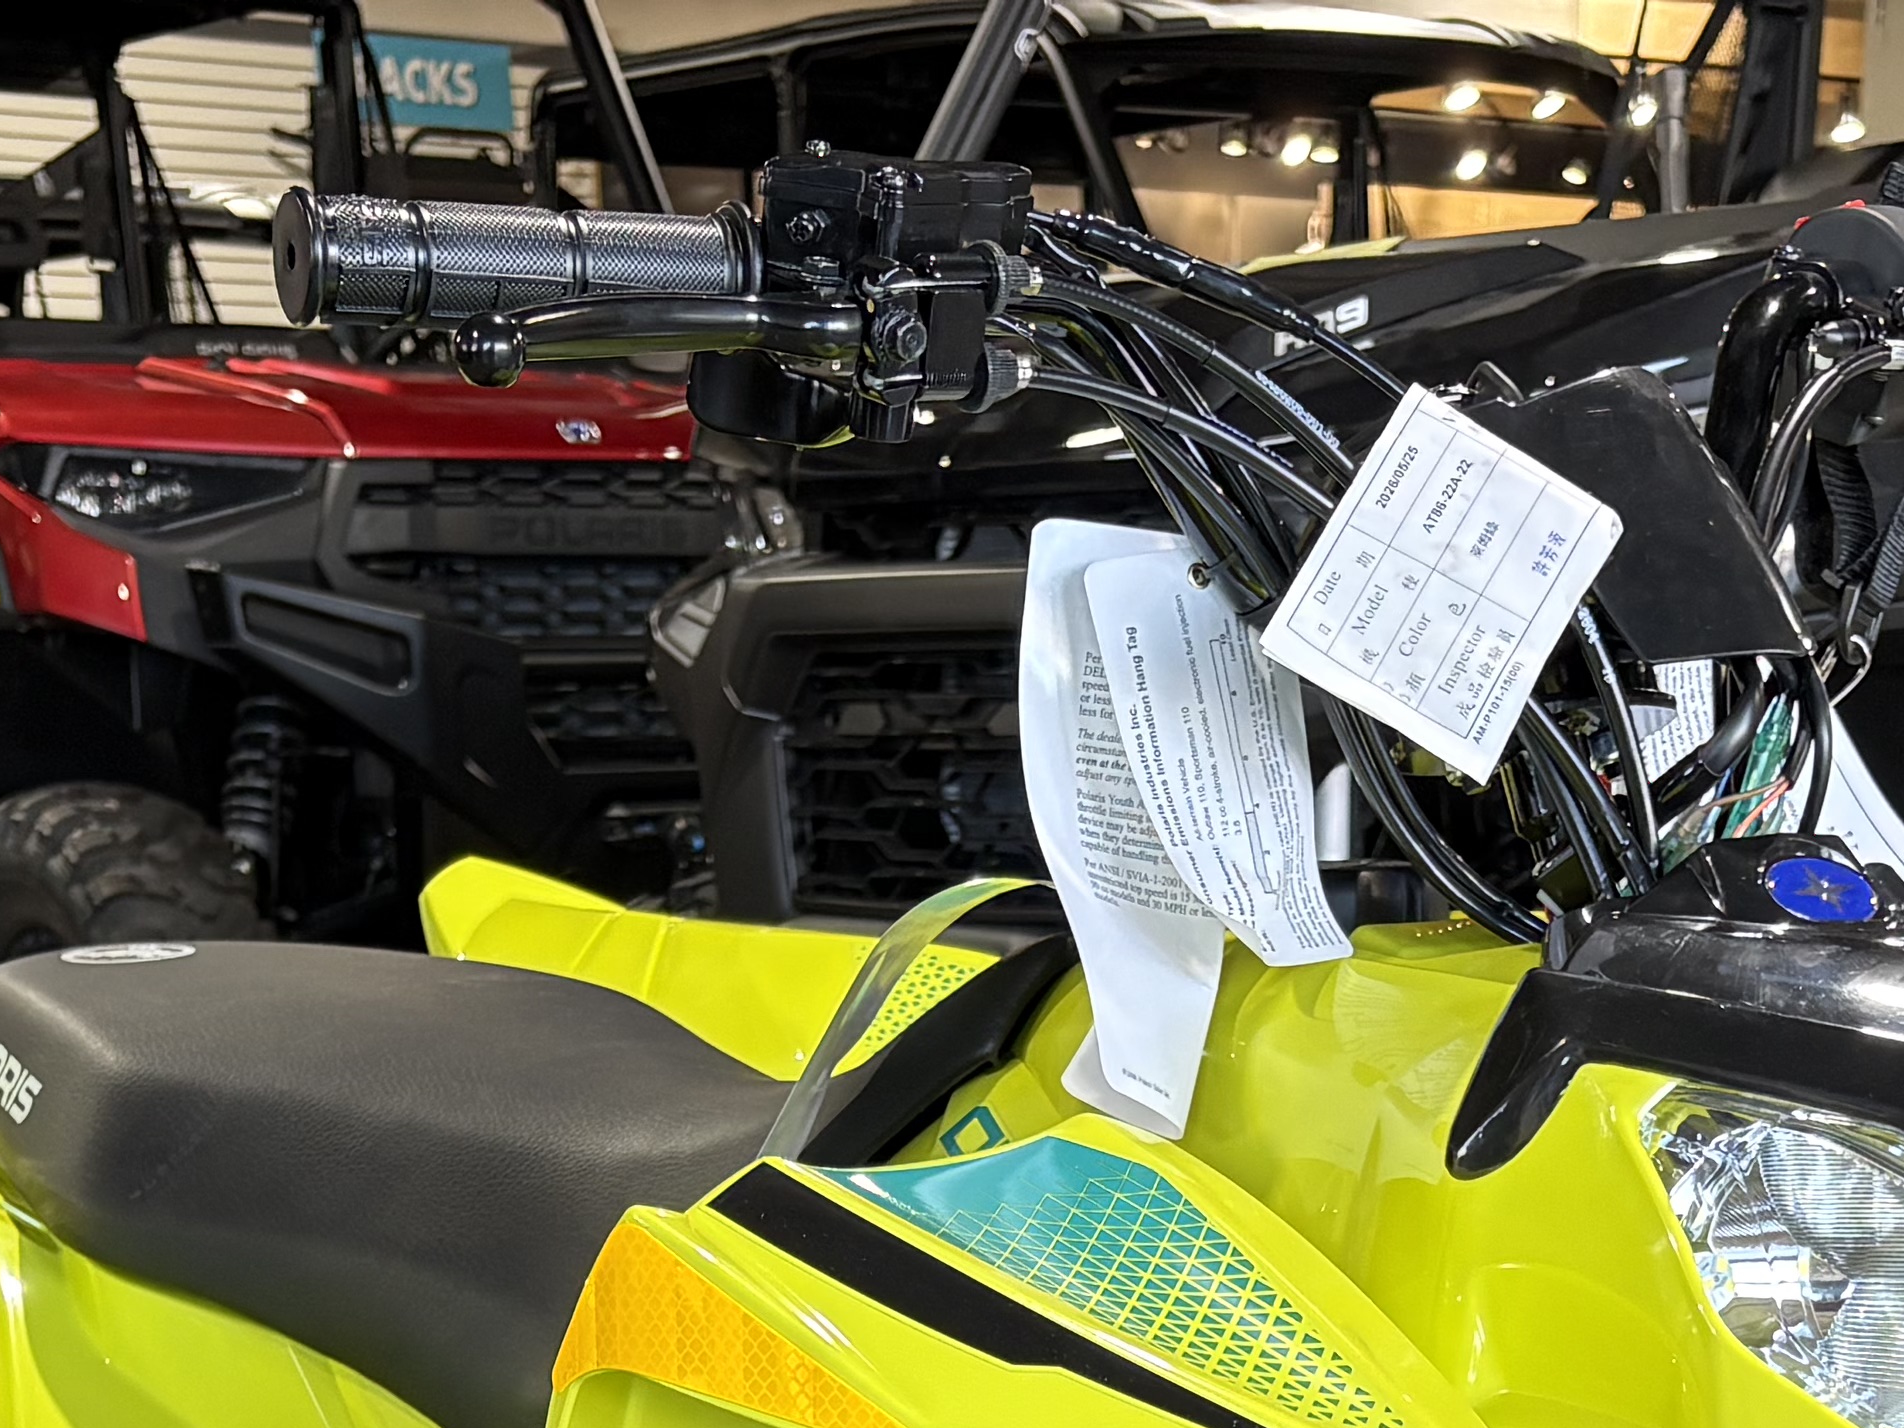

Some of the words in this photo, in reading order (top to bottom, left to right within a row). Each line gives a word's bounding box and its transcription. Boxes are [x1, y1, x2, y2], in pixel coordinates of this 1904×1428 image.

[1312, 568, 1343, 606] Date
[1174, 593, 1190, 636] injection
[1350, 582, 1390, 636] Model
[1125, 626, 1138, 653] Tag
[1183, 636, 1194, 656] fuel
[1396, 610, 1434, 659] Color
[1086, 652, 1101, 664] Per
[1435, 621, 1489, 696] Inspector
[1133, 655, 1147, 692] Hang
[1079, 704, 1097, 717] less
[1093, 694, 1112, 706] less
[1129, 703, 1141, 730] Inc.
[1181, 706, 1192, 724] 110
[1077, 728, 1095, 739] The
[1140, 695, 1166, 775] Information
[1076, 757, 1098, 766] even
[1110, 760, 1126, 770] the
[1076, 768, 1103, 782] adjust
[1134, 733, 1159, 800] Industries
[1076, 788, 1105, 803] Polaris
[1108, 793, 1135, 808] Youth
[1077, 814, 1105, 828] device
[1106, 820, 1124, 833] may
[1161, 779, 1189, 847] Emissions
[1157, 804, 1179, 848] Polaris
[1122, 848, 1159, 866] handling
[1185, 850, 1213, 905] onsumer
[1145, 884, 1168, 901] speed
[1164, 901, 1188, 917] MPH
